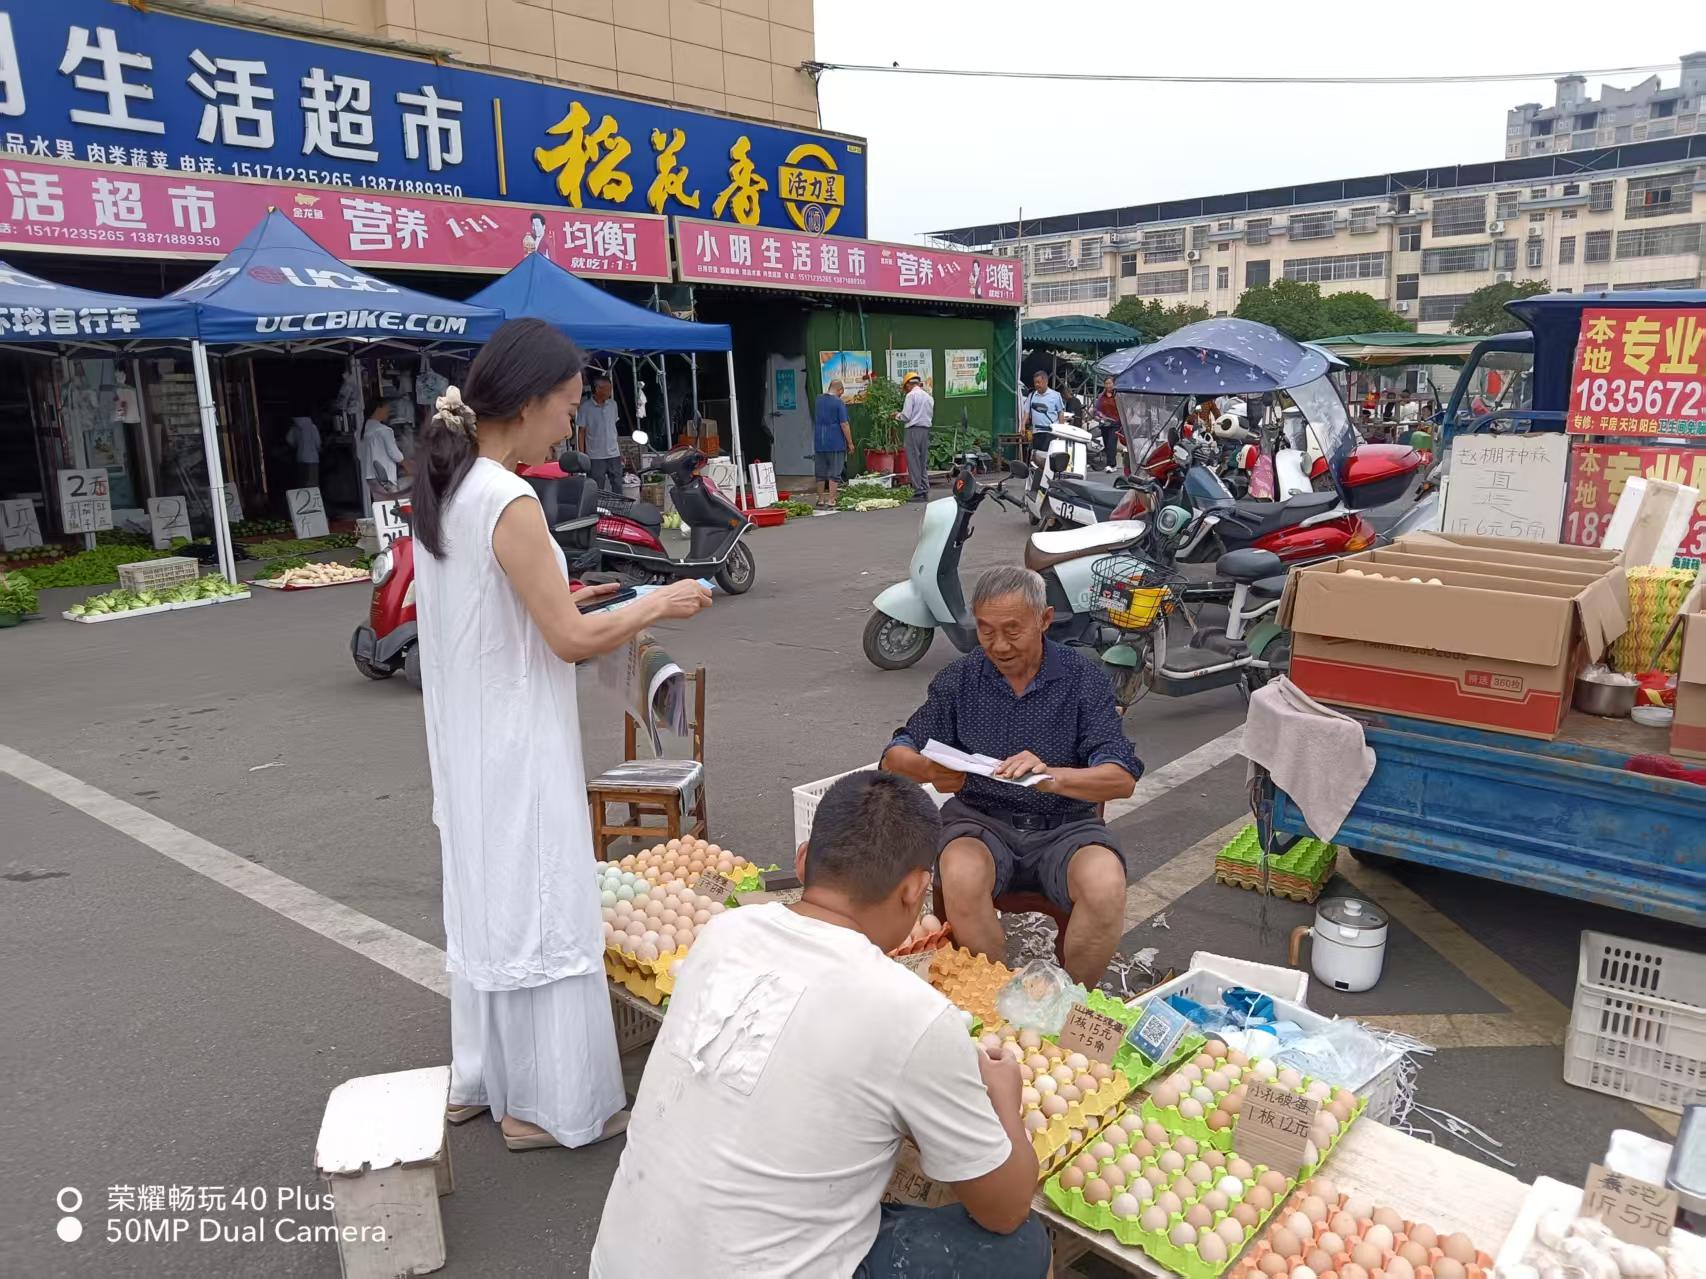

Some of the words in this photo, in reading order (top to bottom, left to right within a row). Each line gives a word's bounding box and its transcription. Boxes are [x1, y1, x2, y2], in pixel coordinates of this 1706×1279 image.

[232, 161, 353, 188] 15171235265
[359, 175, 463, 198] 13871889350
[534, 101, 768, 225] 稻花香
[2, 168, 216, 234] 活超市
[788, 172, 838, 202] 活力星
[25, 224, 125, 241] 15171235265
[130, 232, 221, 246] 13871889350
[340, 197, 429, 251] 营养
[563, 221, 637, 261] 均衡
[696, 230, 866, 276] 小明生活超市
[896, 251, 934, 287] 营养
[985, 263, 1014, 291] 均衡
[256, 310, 467, 335] UCCBIKE.COM
[1577, 378, 1706, 415] 1835672
[1600, 416, 1617, 431] 平房
[1061, 502, 1075, 521] 03
[1248, 1105, 1309, 1138] 1板12元
